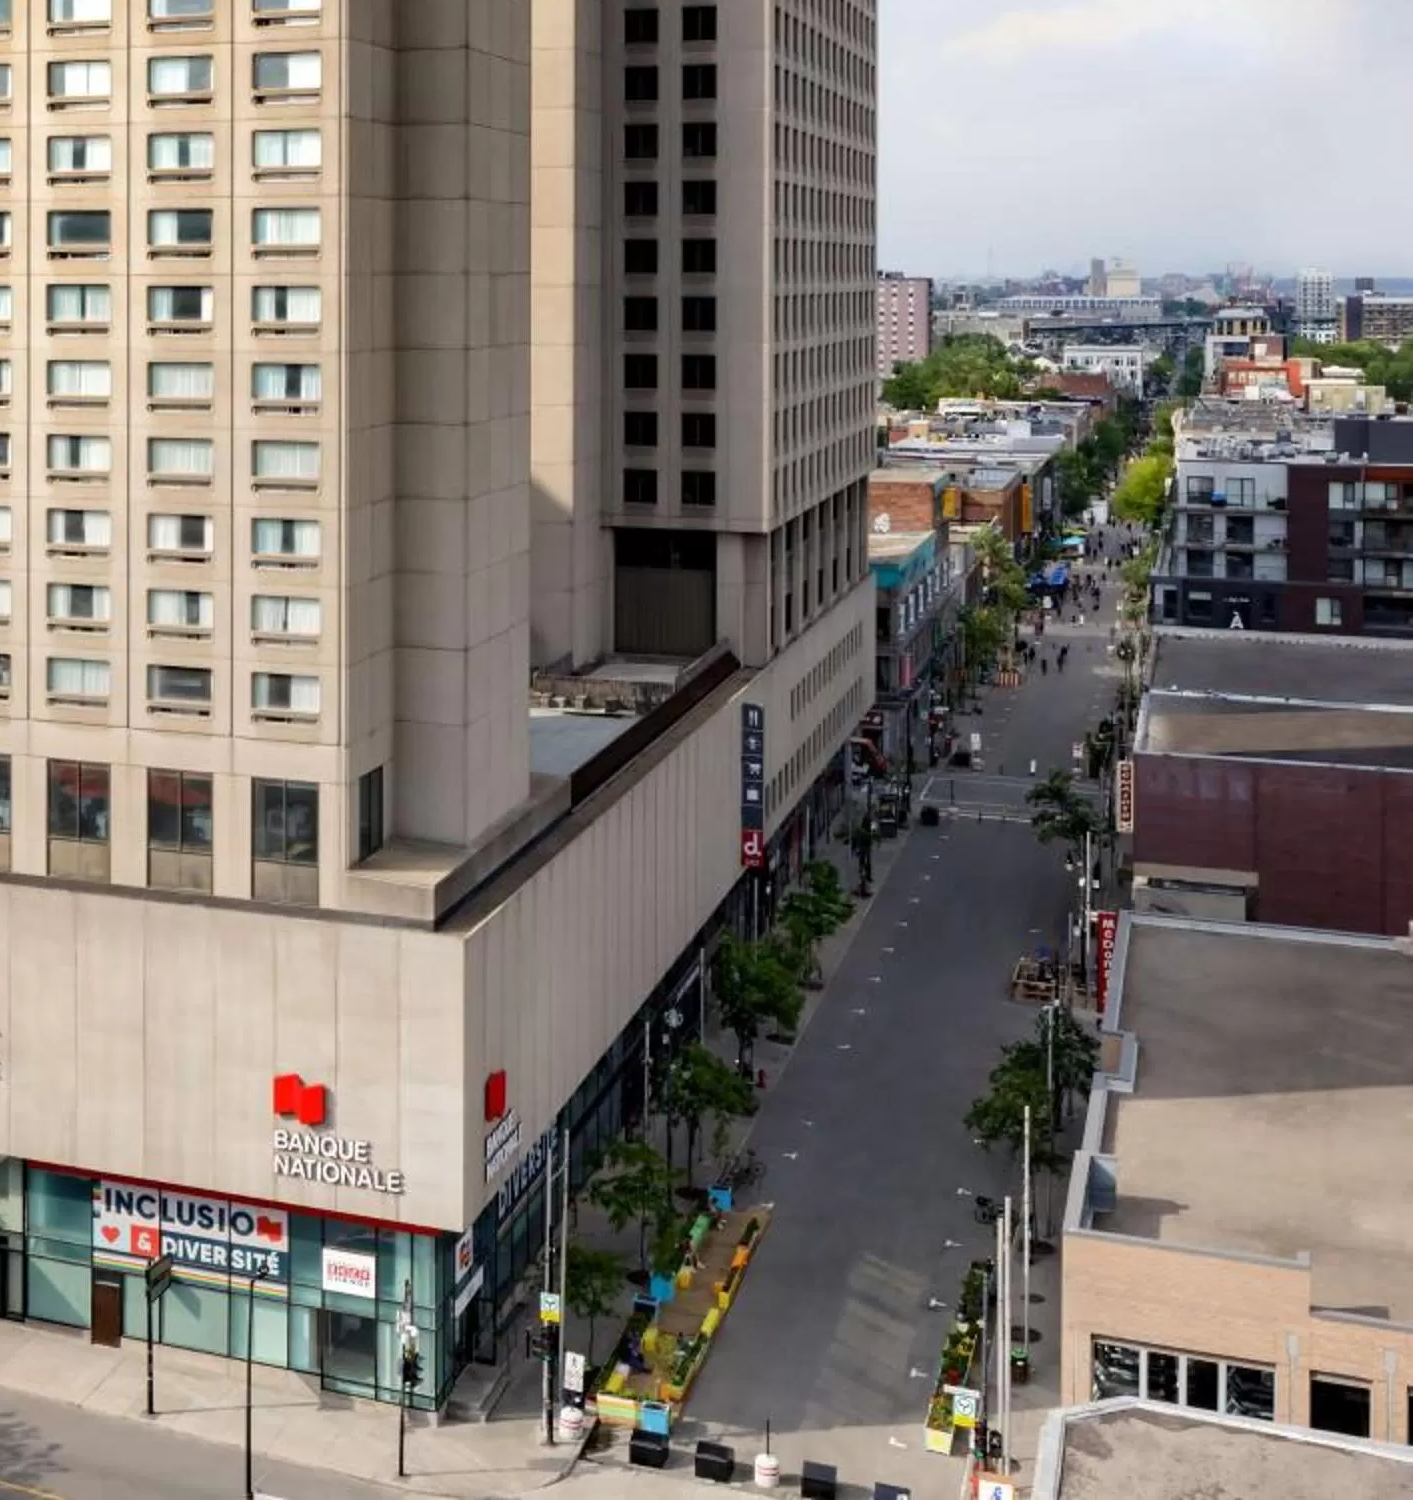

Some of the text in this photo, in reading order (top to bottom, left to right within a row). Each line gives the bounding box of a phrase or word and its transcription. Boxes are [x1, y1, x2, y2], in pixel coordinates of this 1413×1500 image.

[274, 1129, 369, 1162] BANQUE
[274, 1155, 403, 1192] NATIONALE
[162, 1235, 281, 1276] DIVERSITÉ
